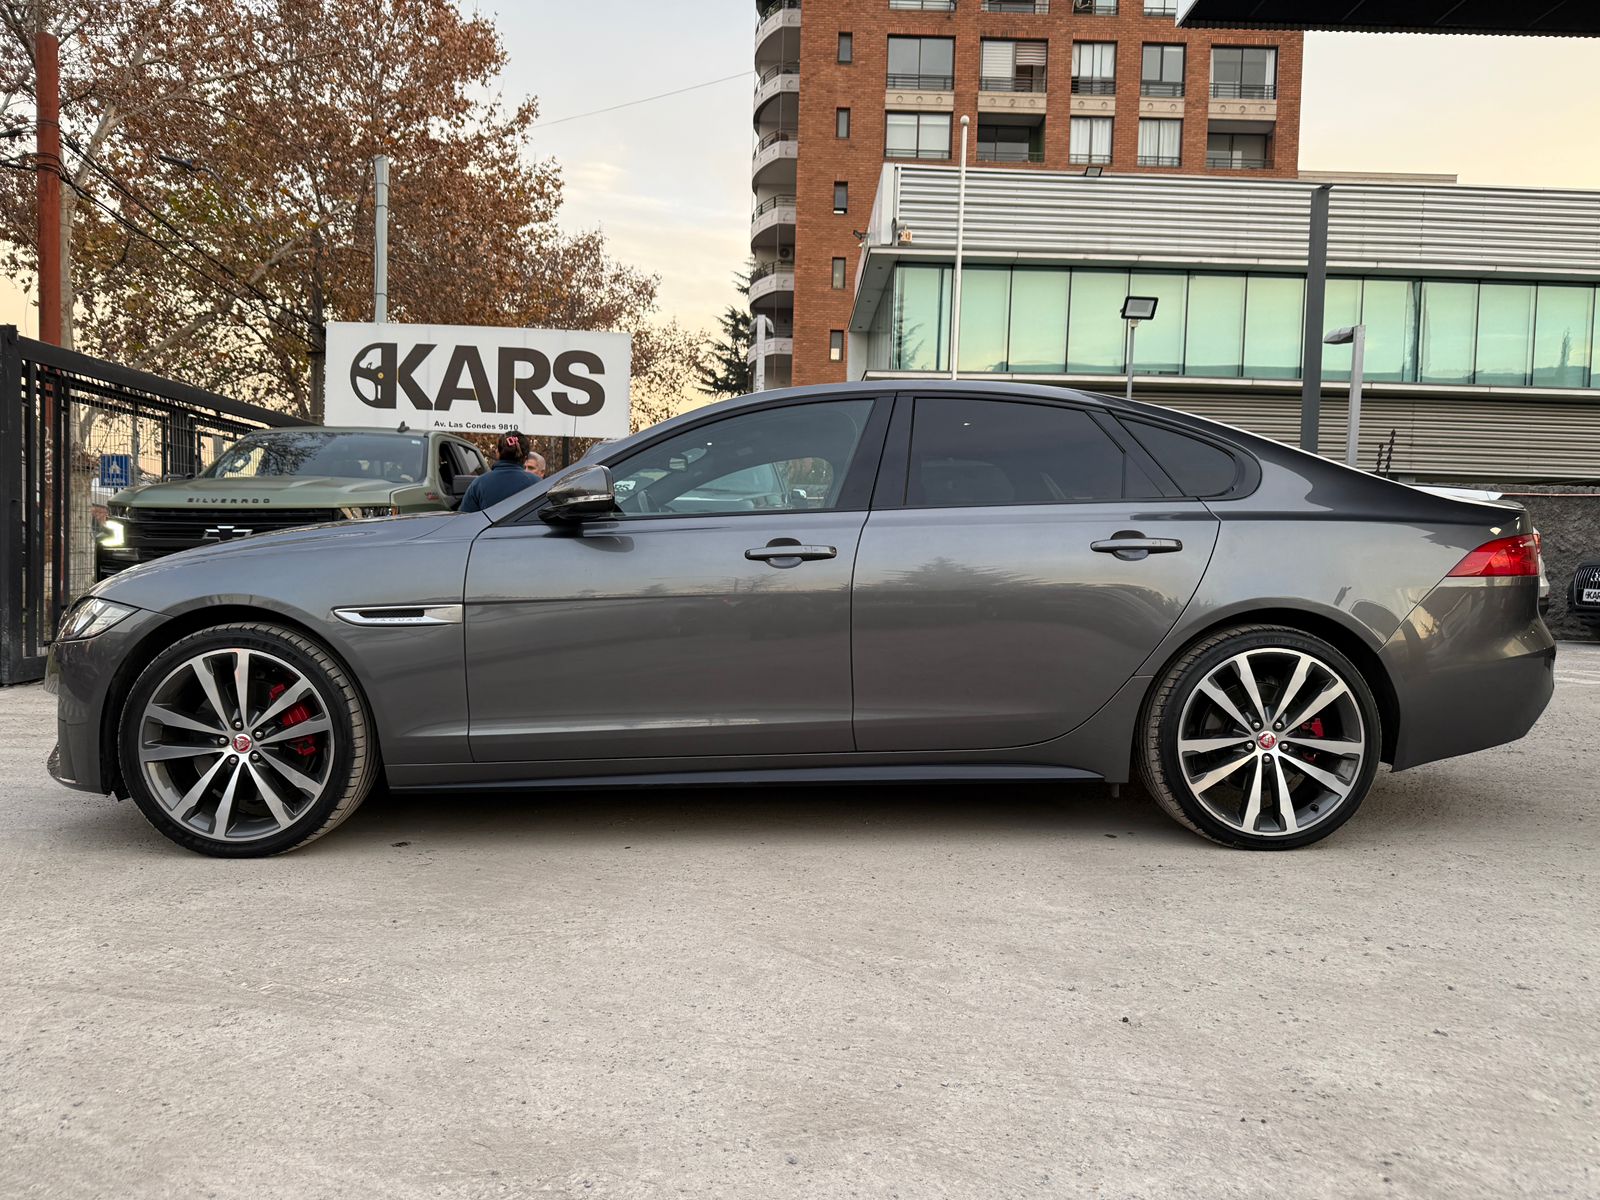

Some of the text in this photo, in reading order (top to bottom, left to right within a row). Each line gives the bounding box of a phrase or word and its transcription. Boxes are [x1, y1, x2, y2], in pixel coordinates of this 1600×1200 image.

[397, 343, 606, 417] KARS
[434, 420, 446, 428] Av.
[466, 422, 496, 430] Condes
[186, 497, 271, 505] SILVERADO
